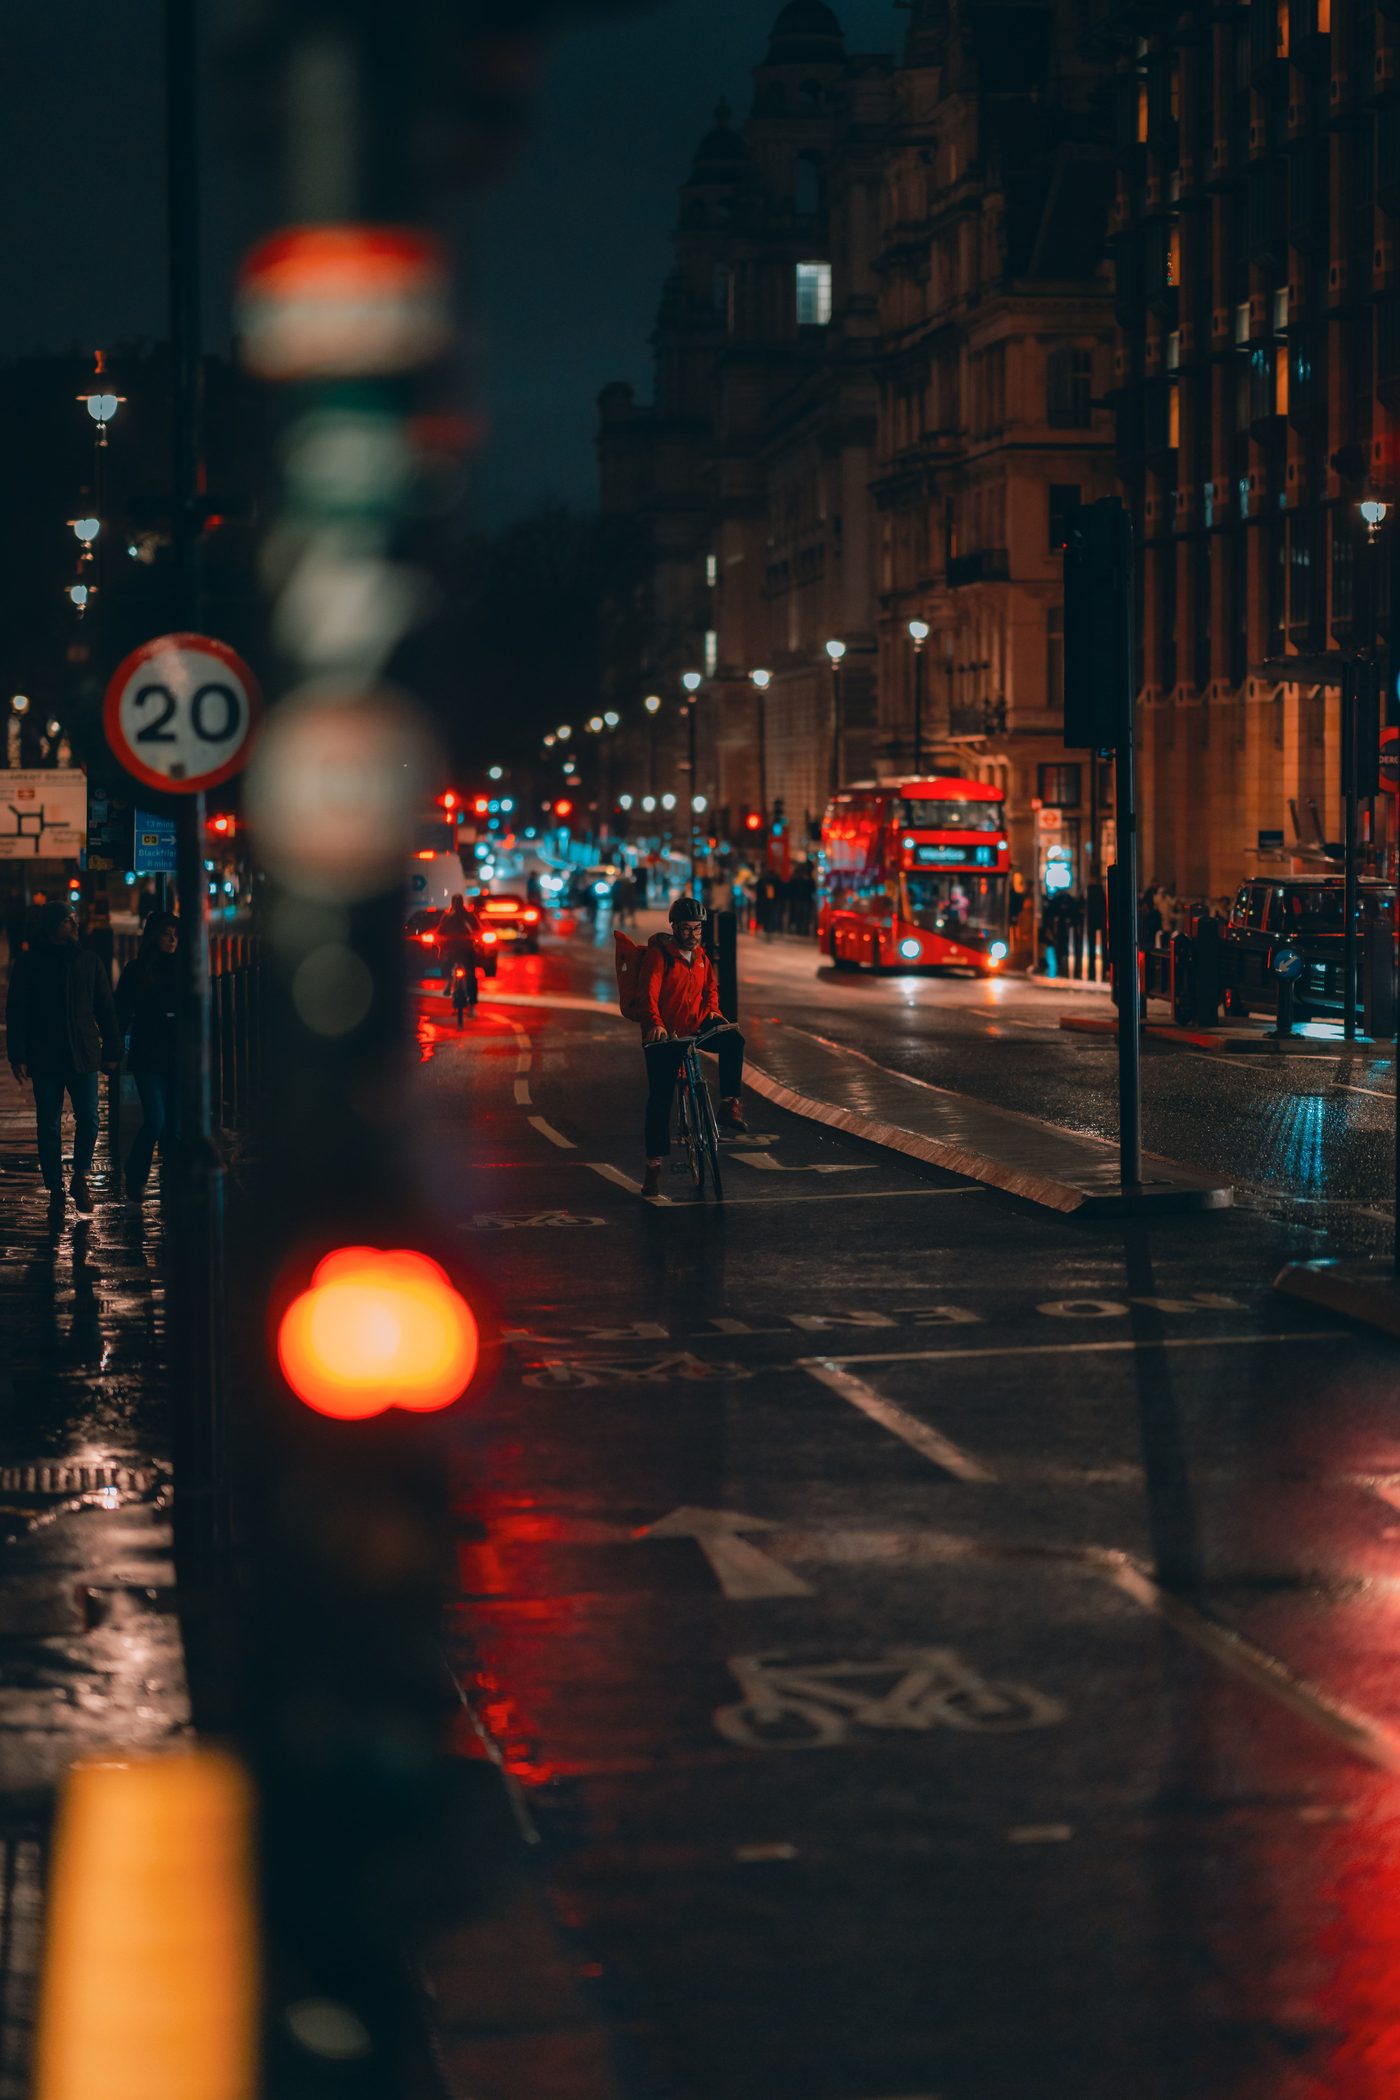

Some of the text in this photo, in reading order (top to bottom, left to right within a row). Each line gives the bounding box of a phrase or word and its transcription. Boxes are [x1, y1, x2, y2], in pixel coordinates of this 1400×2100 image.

[134, 683, 241, 743] 20
[157, 819, 174, 828] mins
[154, 858, 173, 868] mins
[500, 1292, 1252, 1344] NO ENTRY
